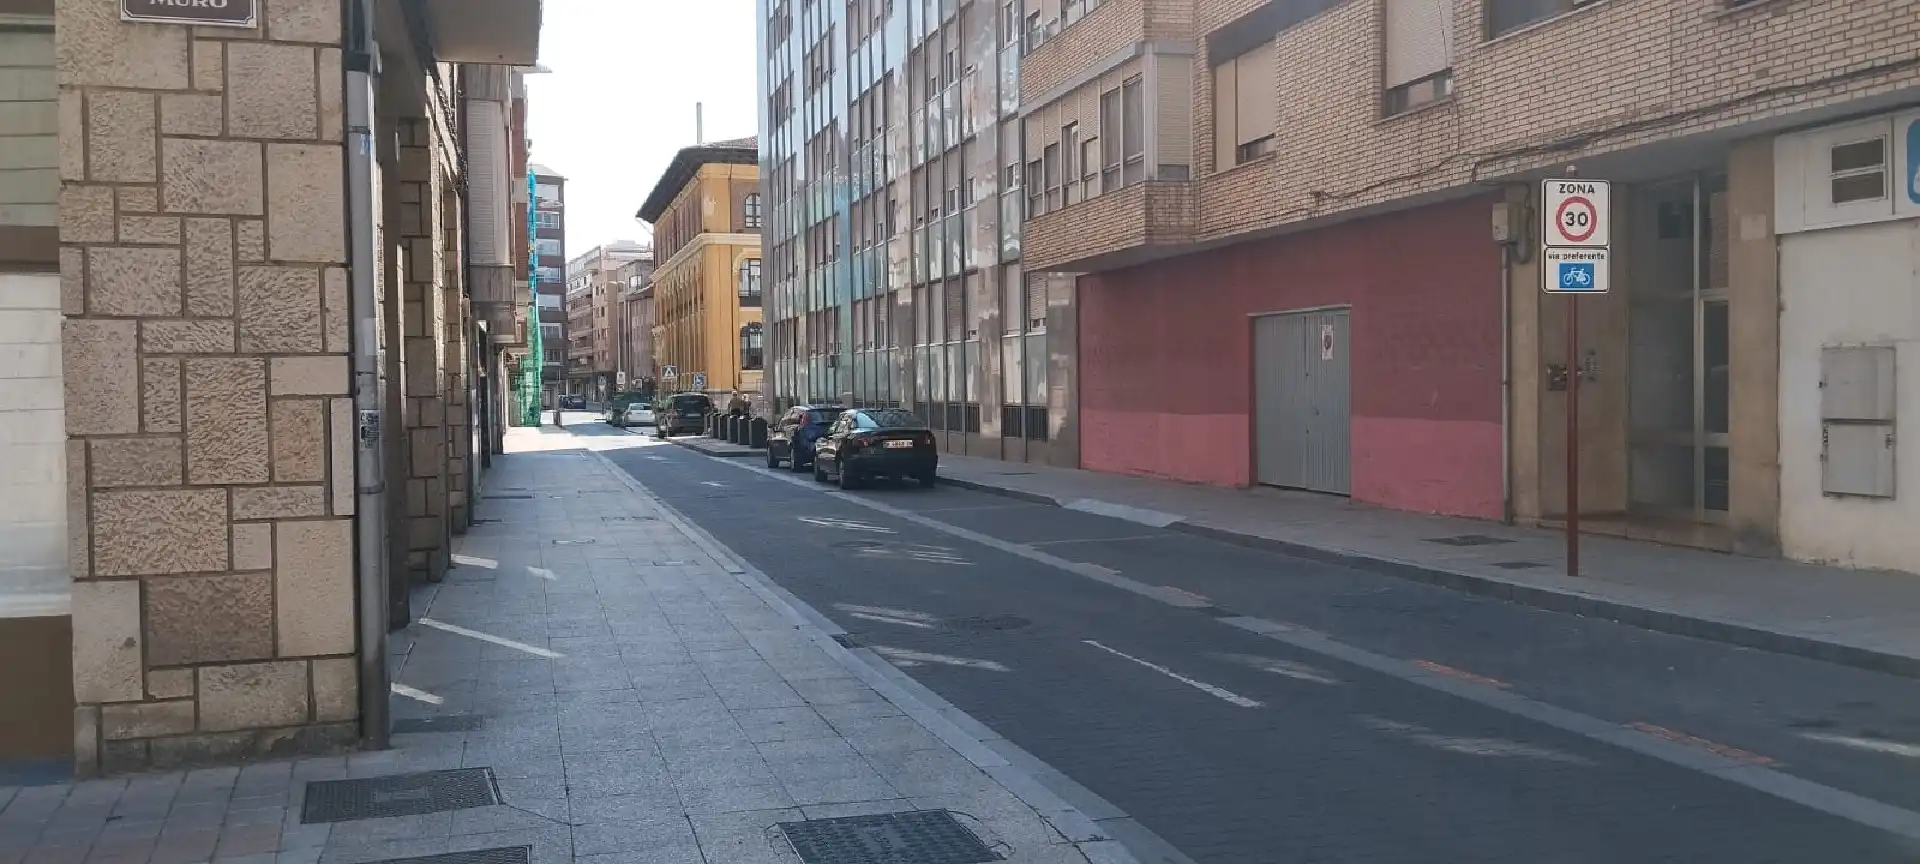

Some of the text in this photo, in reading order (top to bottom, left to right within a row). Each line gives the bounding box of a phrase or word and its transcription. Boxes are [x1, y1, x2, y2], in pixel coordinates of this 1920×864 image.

[1559, 183, 1595, 194] ZONA
[1565, 211, 1588, 227] 30
[1563, 251, 1605, 260] preferente
